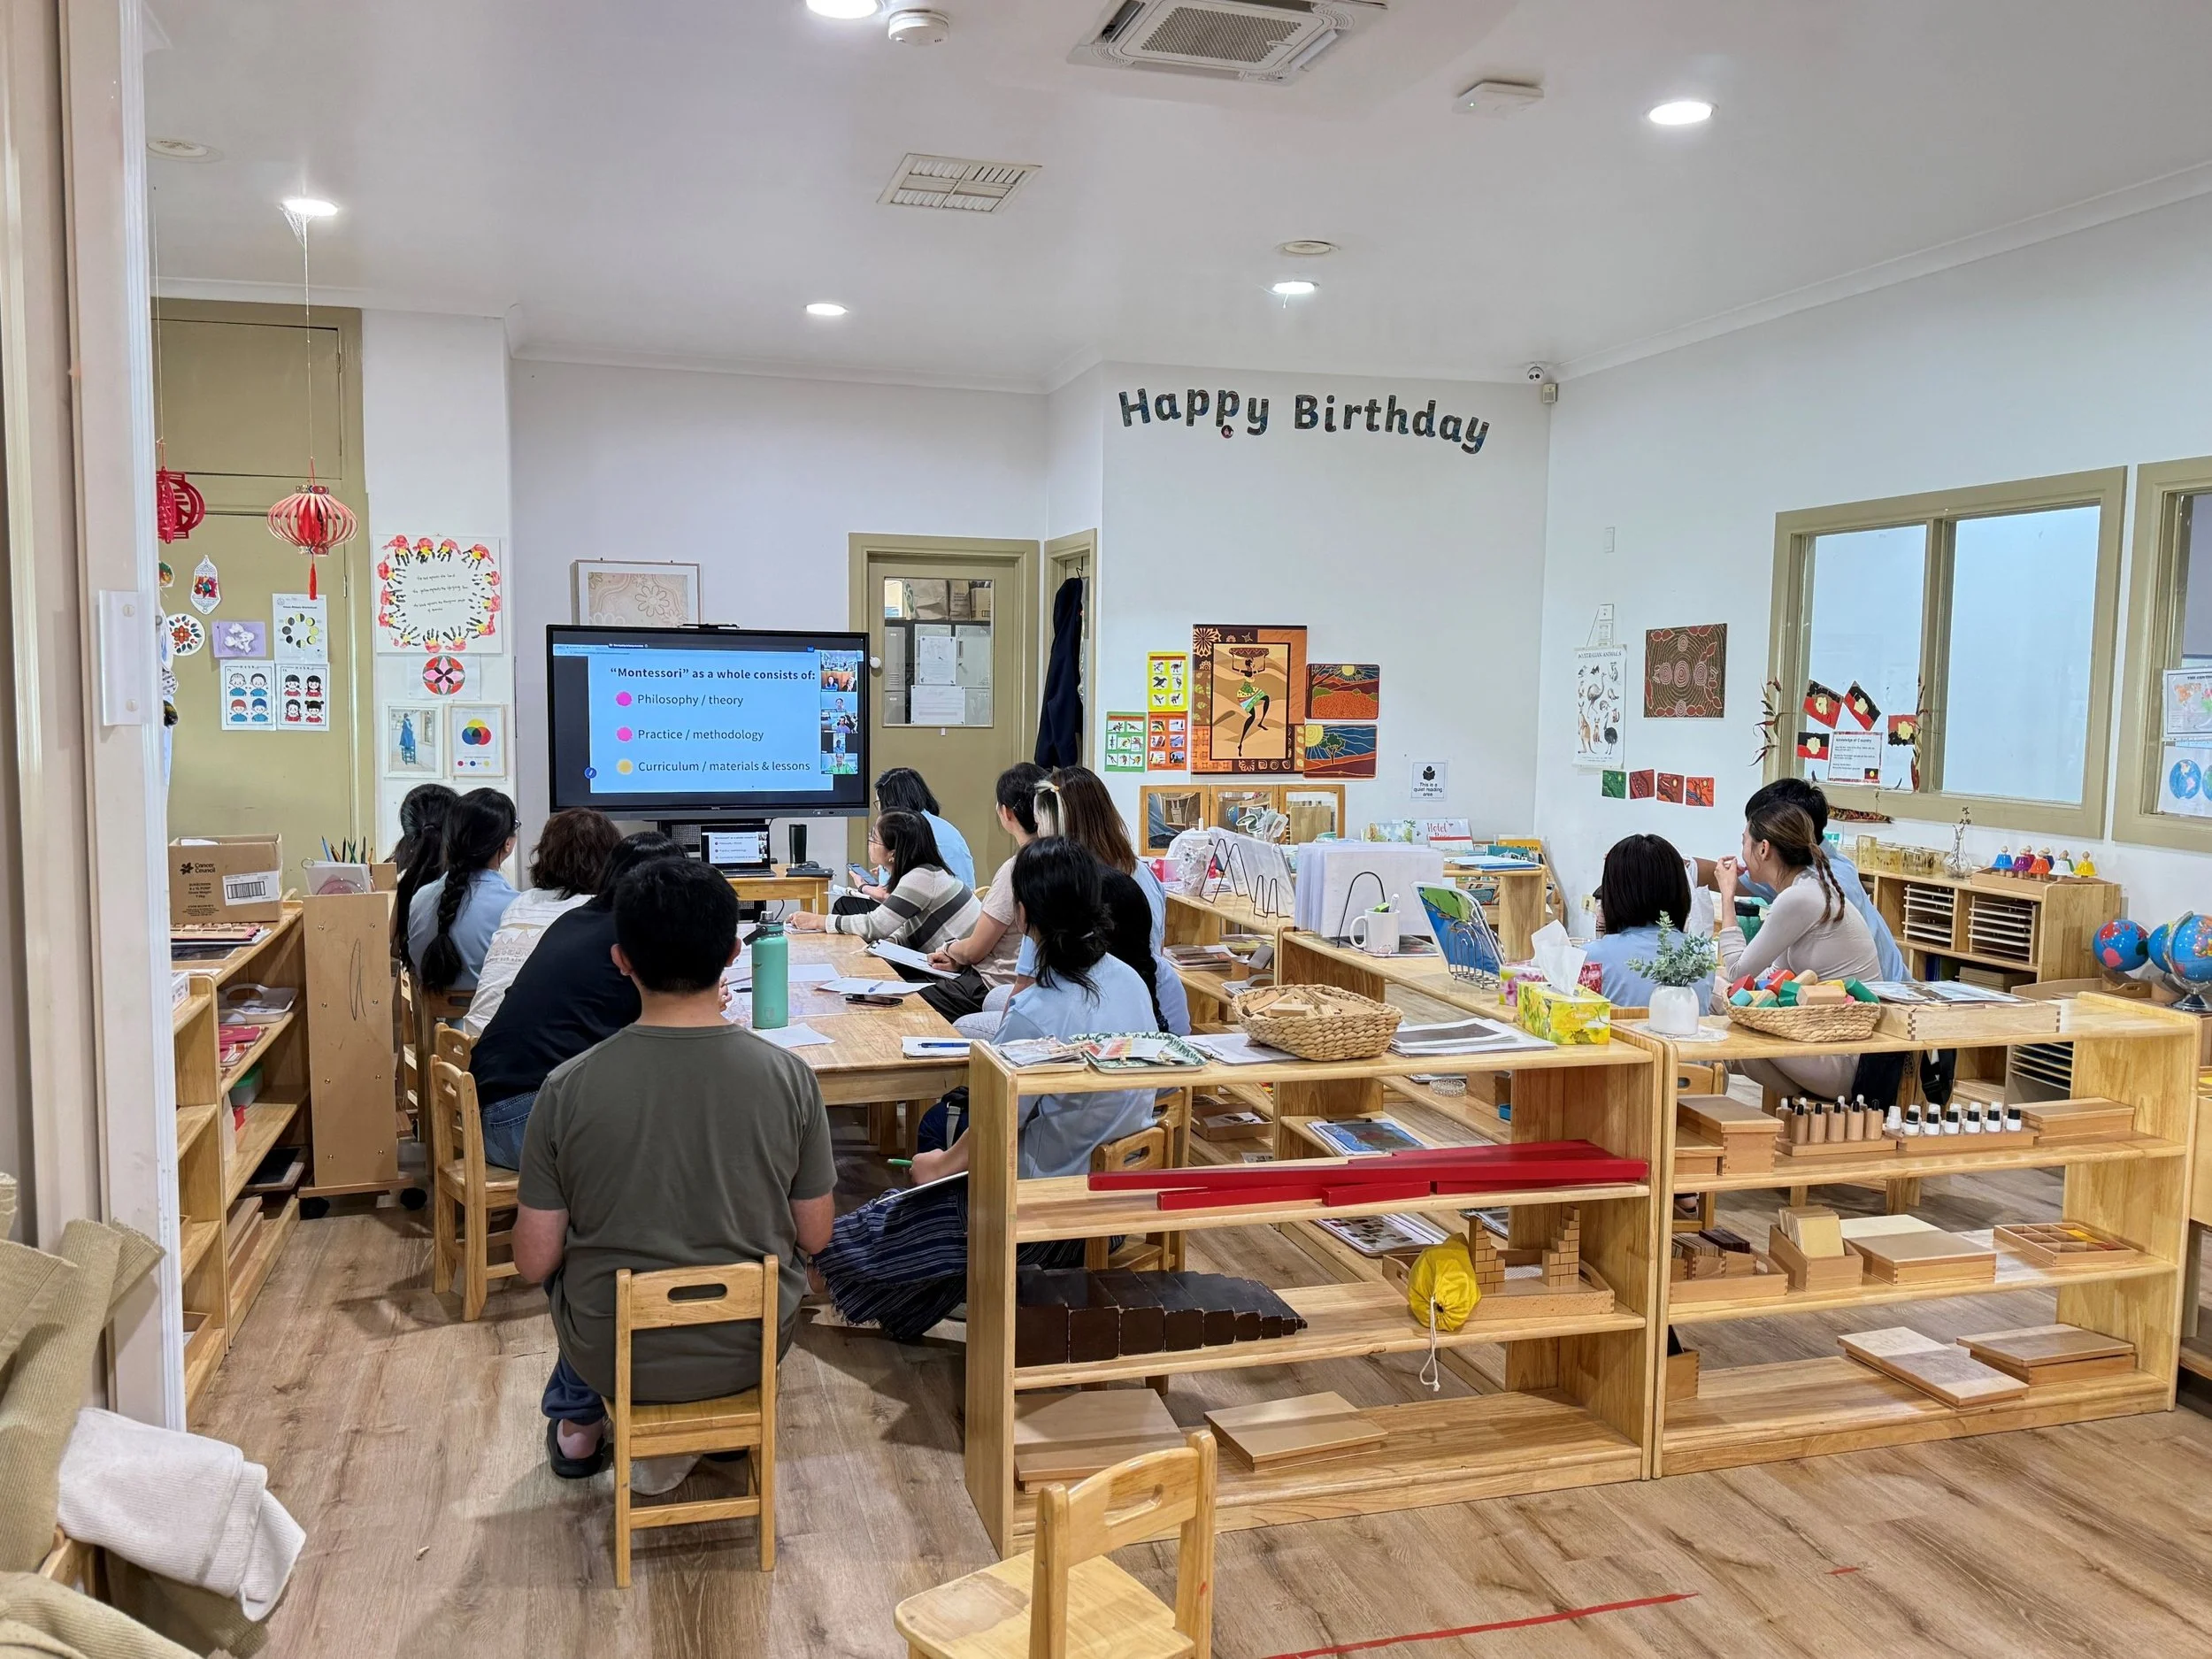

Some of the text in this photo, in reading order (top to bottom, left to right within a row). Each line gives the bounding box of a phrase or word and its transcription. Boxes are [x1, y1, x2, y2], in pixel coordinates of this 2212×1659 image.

[1118, 388, 1490, 454] Happy Birthday
[717, 670, 751, 680] whole
[753, 670, 798, 680] consists
[801, 670, 816, 680] of:
[637, 694, 699, 706] Philosophy
[709, 695, 744, 707] theory
[638, 729, 683, 740] Practice
[693, 729, 764, 741] methodology
[638, 761, 699, 772] Curriculum
[710, 761, 759, 771] materials
[761, 762, 770, 771] &
[772, 761, 810, 771] lessons
[1426, 822, 1448, 833] Hotel
